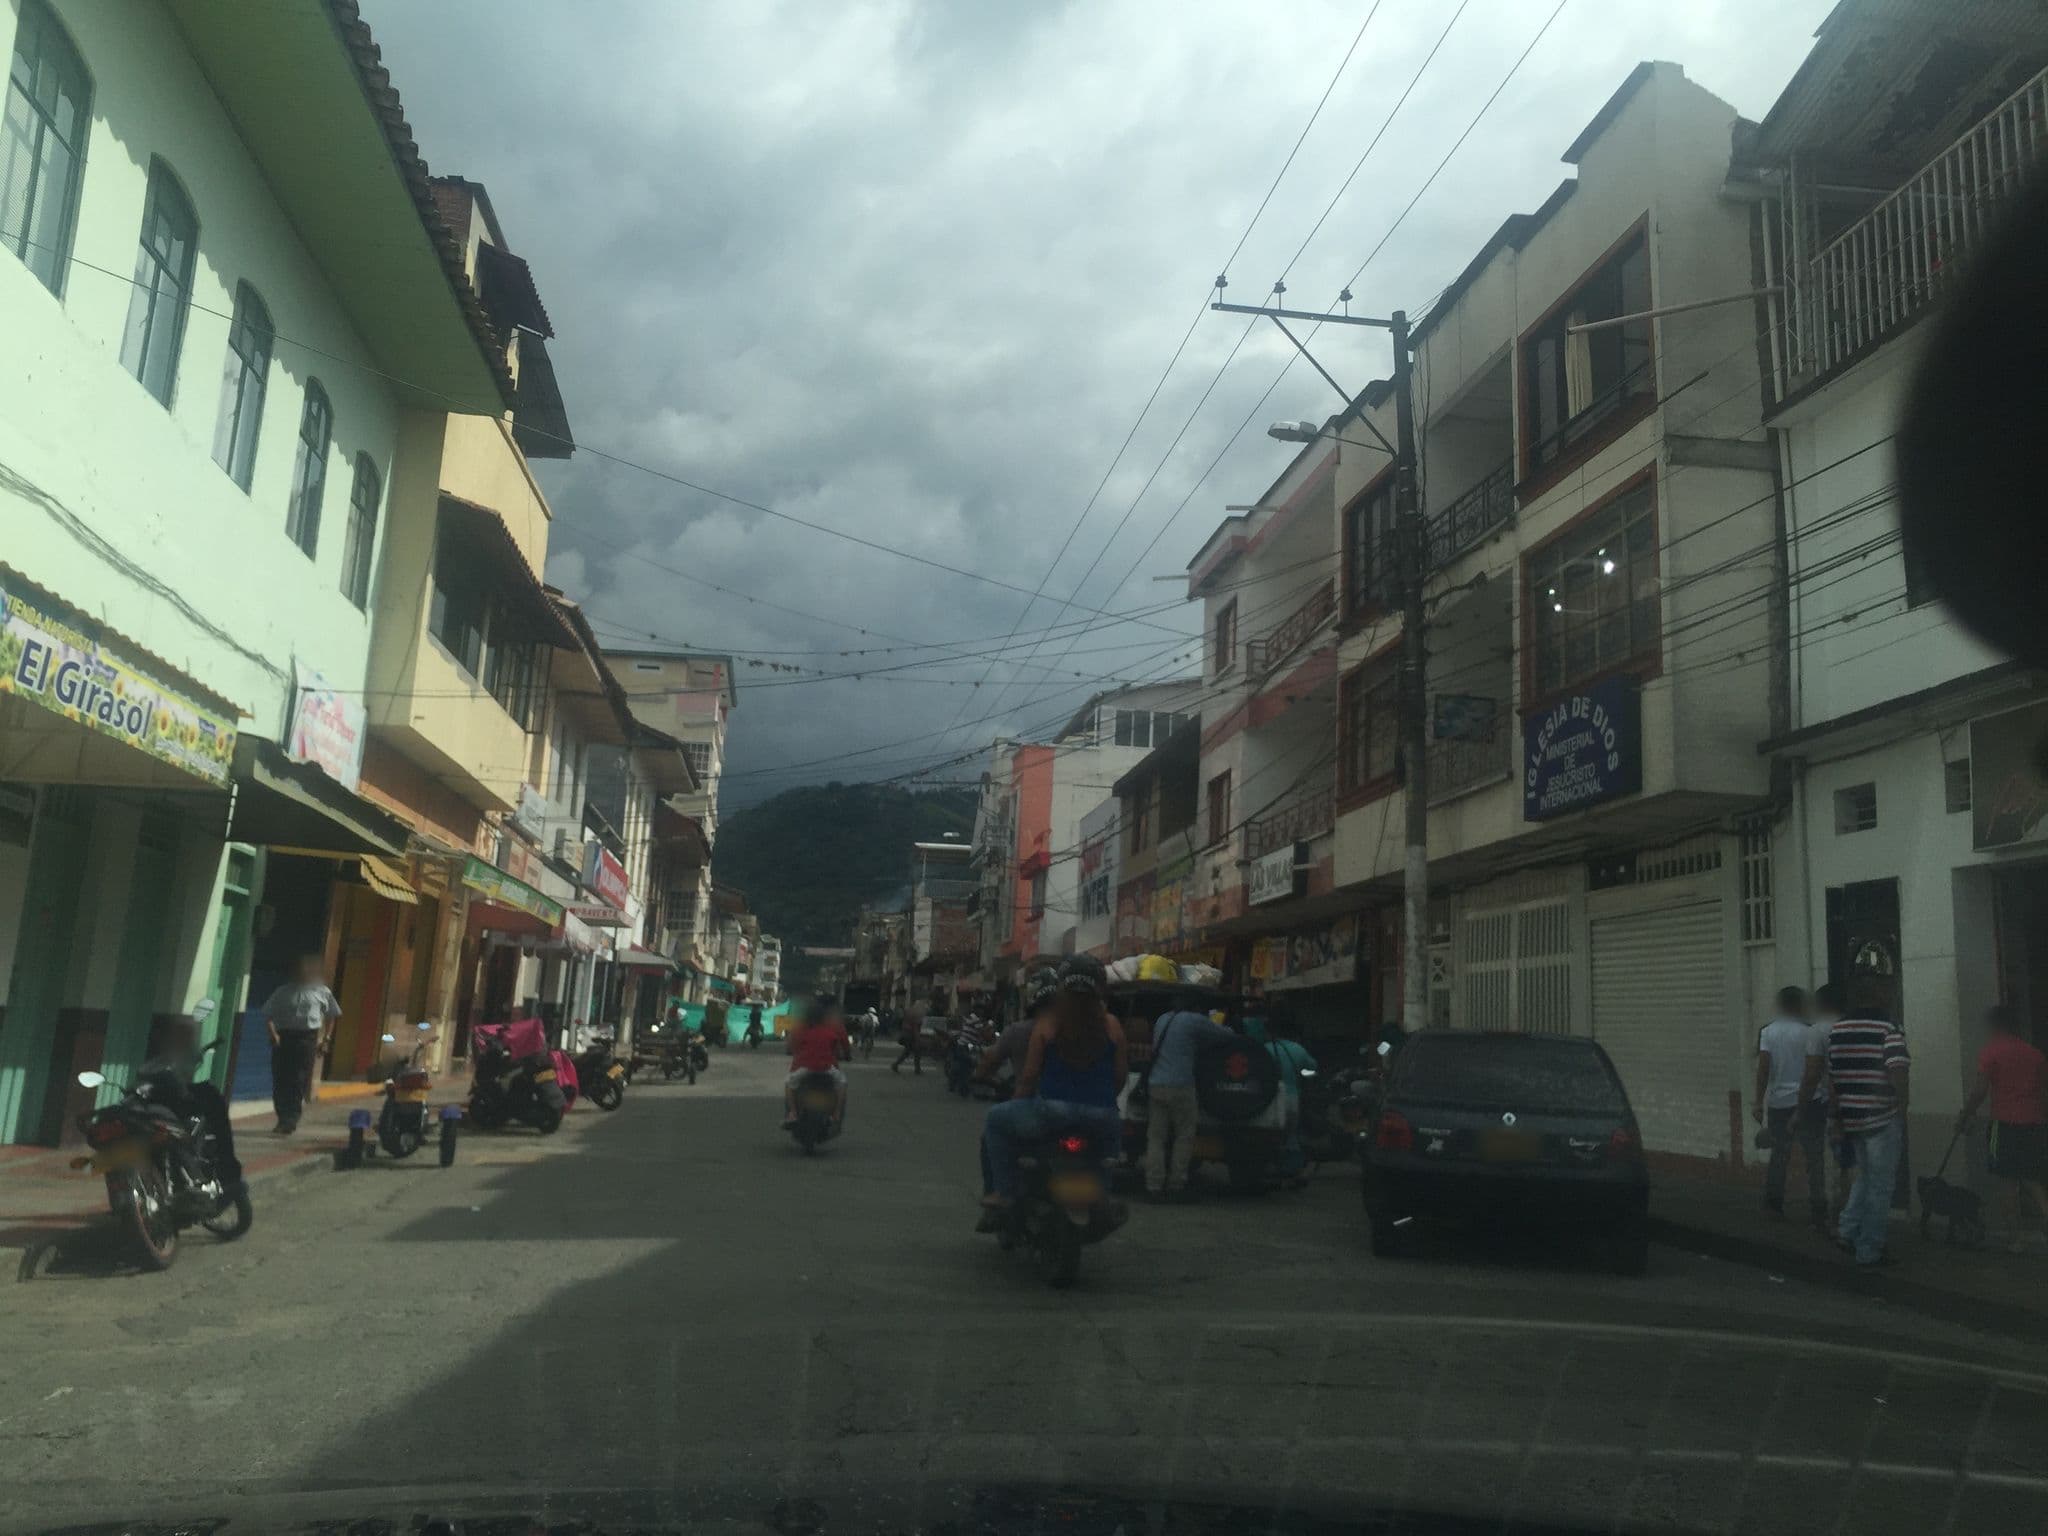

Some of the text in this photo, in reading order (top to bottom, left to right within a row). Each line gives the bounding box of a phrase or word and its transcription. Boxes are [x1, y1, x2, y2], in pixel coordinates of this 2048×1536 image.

[6, 594, 43, 626] TIENDA
[16, 638, 53, 692] El
[55, 660, 153, 740] Girasol
[1526, 696, 1619, 799] IGLESIA DE DIOS
[1545, 729, 1595, 761] MINISTERIAL
[1545, 762, 1596, 793] JESUCRISTO
[1563, 753, 1576, 770] DE
[1539, 776, 1604, 811] INTERNACIONAL
